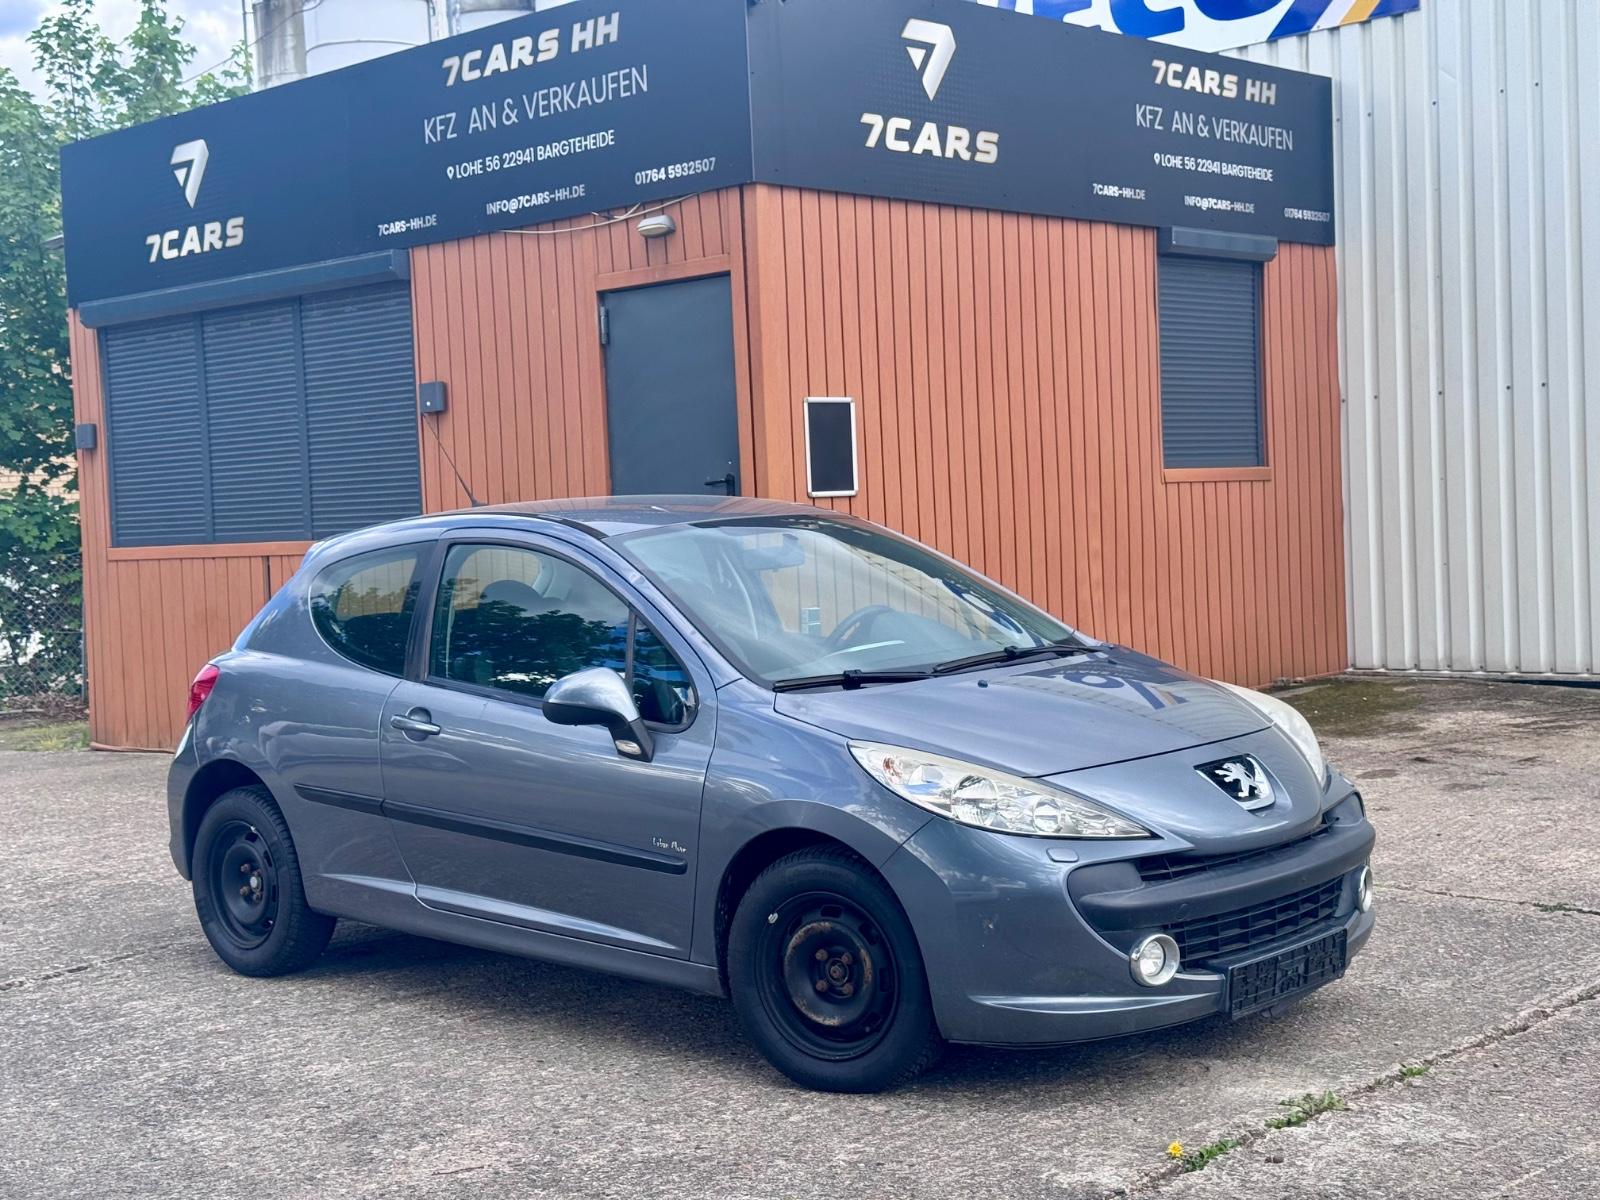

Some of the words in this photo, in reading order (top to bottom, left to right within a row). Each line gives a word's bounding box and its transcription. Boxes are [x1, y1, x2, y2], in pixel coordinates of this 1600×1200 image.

[441, 28, 560, 87] 7CARS
[570, 12, 620, 53] HH
[424, 112, 458, 144] KFZ
[468, 102, 497, 134] AN
[502, 98, 518, 125] &
[522, 64, 648, 120] VERKAUFEN
[1152, 59, 1238, 99] 7CARS
[1245, 78, 1277, 105] HH
[860, 112, 1000, 164] 7CARS
[1135, 103, 1164, 130] KFZ
[1171, 111, 1194, 135] AN
[1197, 114, 1210, 138] &
[1212, 117, 1293, 150] VERKAUFEN
[456, 159, 483, 179] LOHE
[485, 155, 500, 172] 56
[502, 147, 534, 168] 22941
[537, 129, 615, 161] BARGTEHEIDE
[634, 168, 666, 185] 01764
[667, 157, 716, 180] 5932507
[1161, 153, 1183, 170] LOHE
[1184, 156, 1196, 171] 56
[1197, 158, 1221, 175] 22941
[1221, 162, 1274, 182] BARGTEHEIDE
[486, 184, 586, 215] INFO@7CARS-HH.DE
[1093, 183, 1146, 200] 7CARS-HH.DE
[1184, 195, 1255, 214] INFO@7CARS-HH.DE
[145, 216, 244, 263] 7CARS
[378, 214, 437, 236] 7CARS-HH.DE
